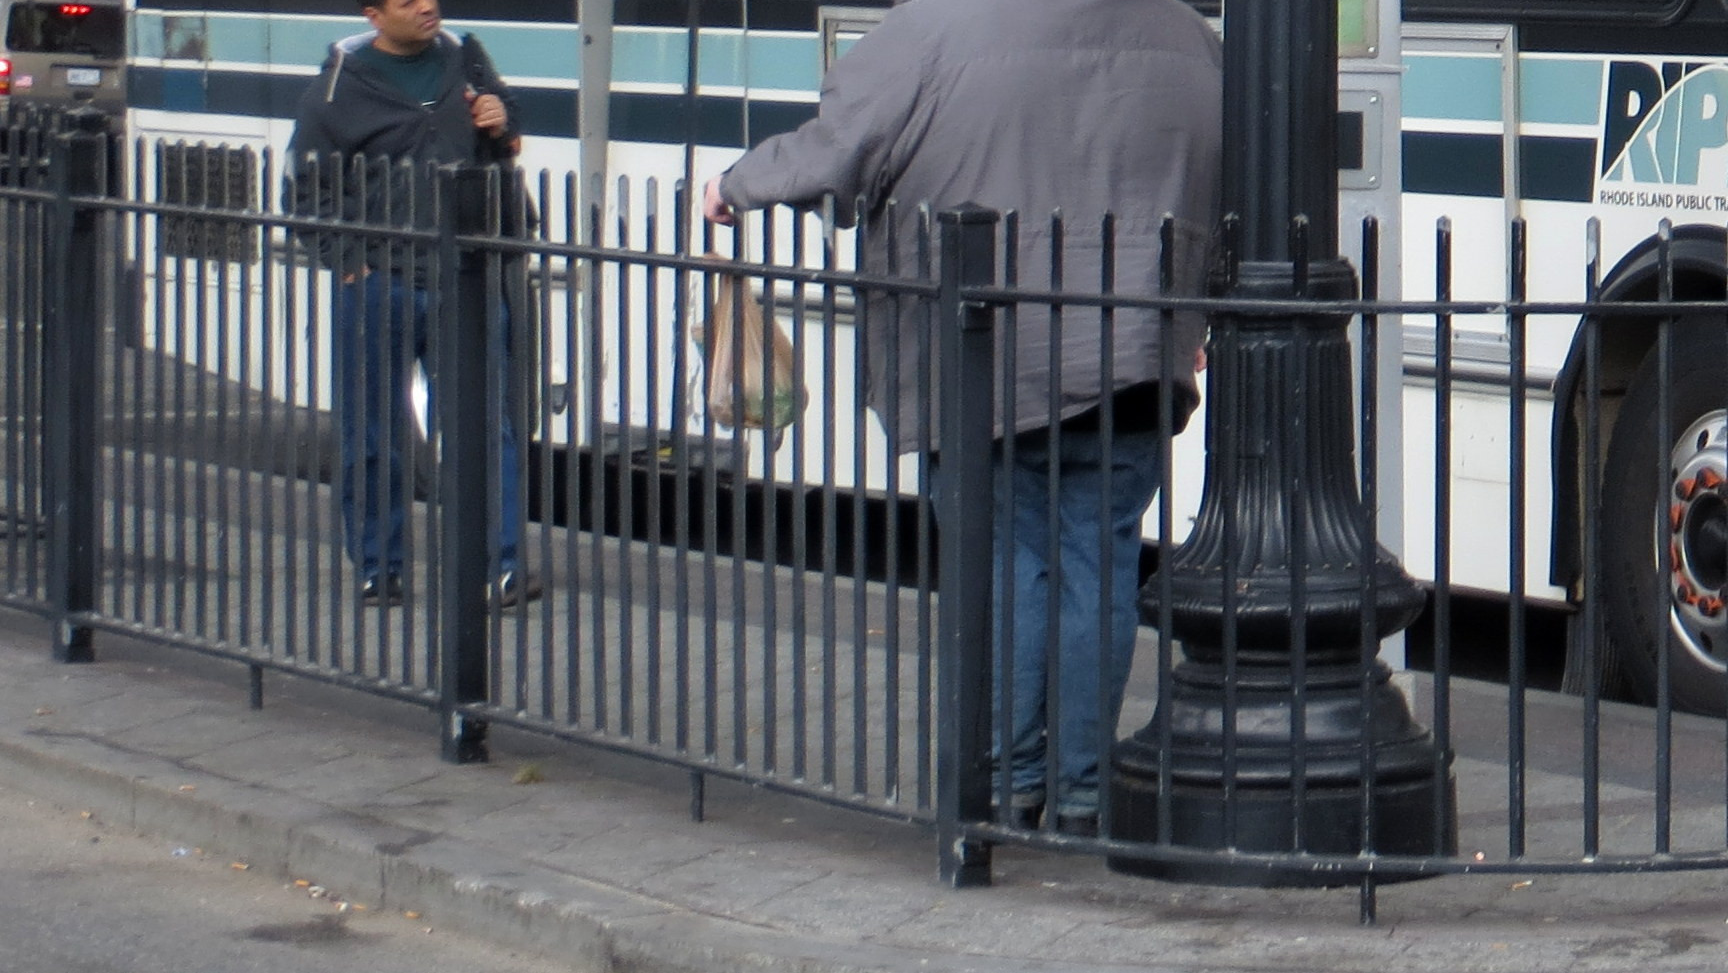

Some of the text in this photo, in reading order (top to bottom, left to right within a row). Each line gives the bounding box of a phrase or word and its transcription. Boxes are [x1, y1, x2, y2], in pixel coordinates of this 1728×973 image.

[1600, 189, 1634, 206] RHODE
[1636, 192, 1673, 208] ISLAND
[1676, 194, 1710, 211] PUBLIC
